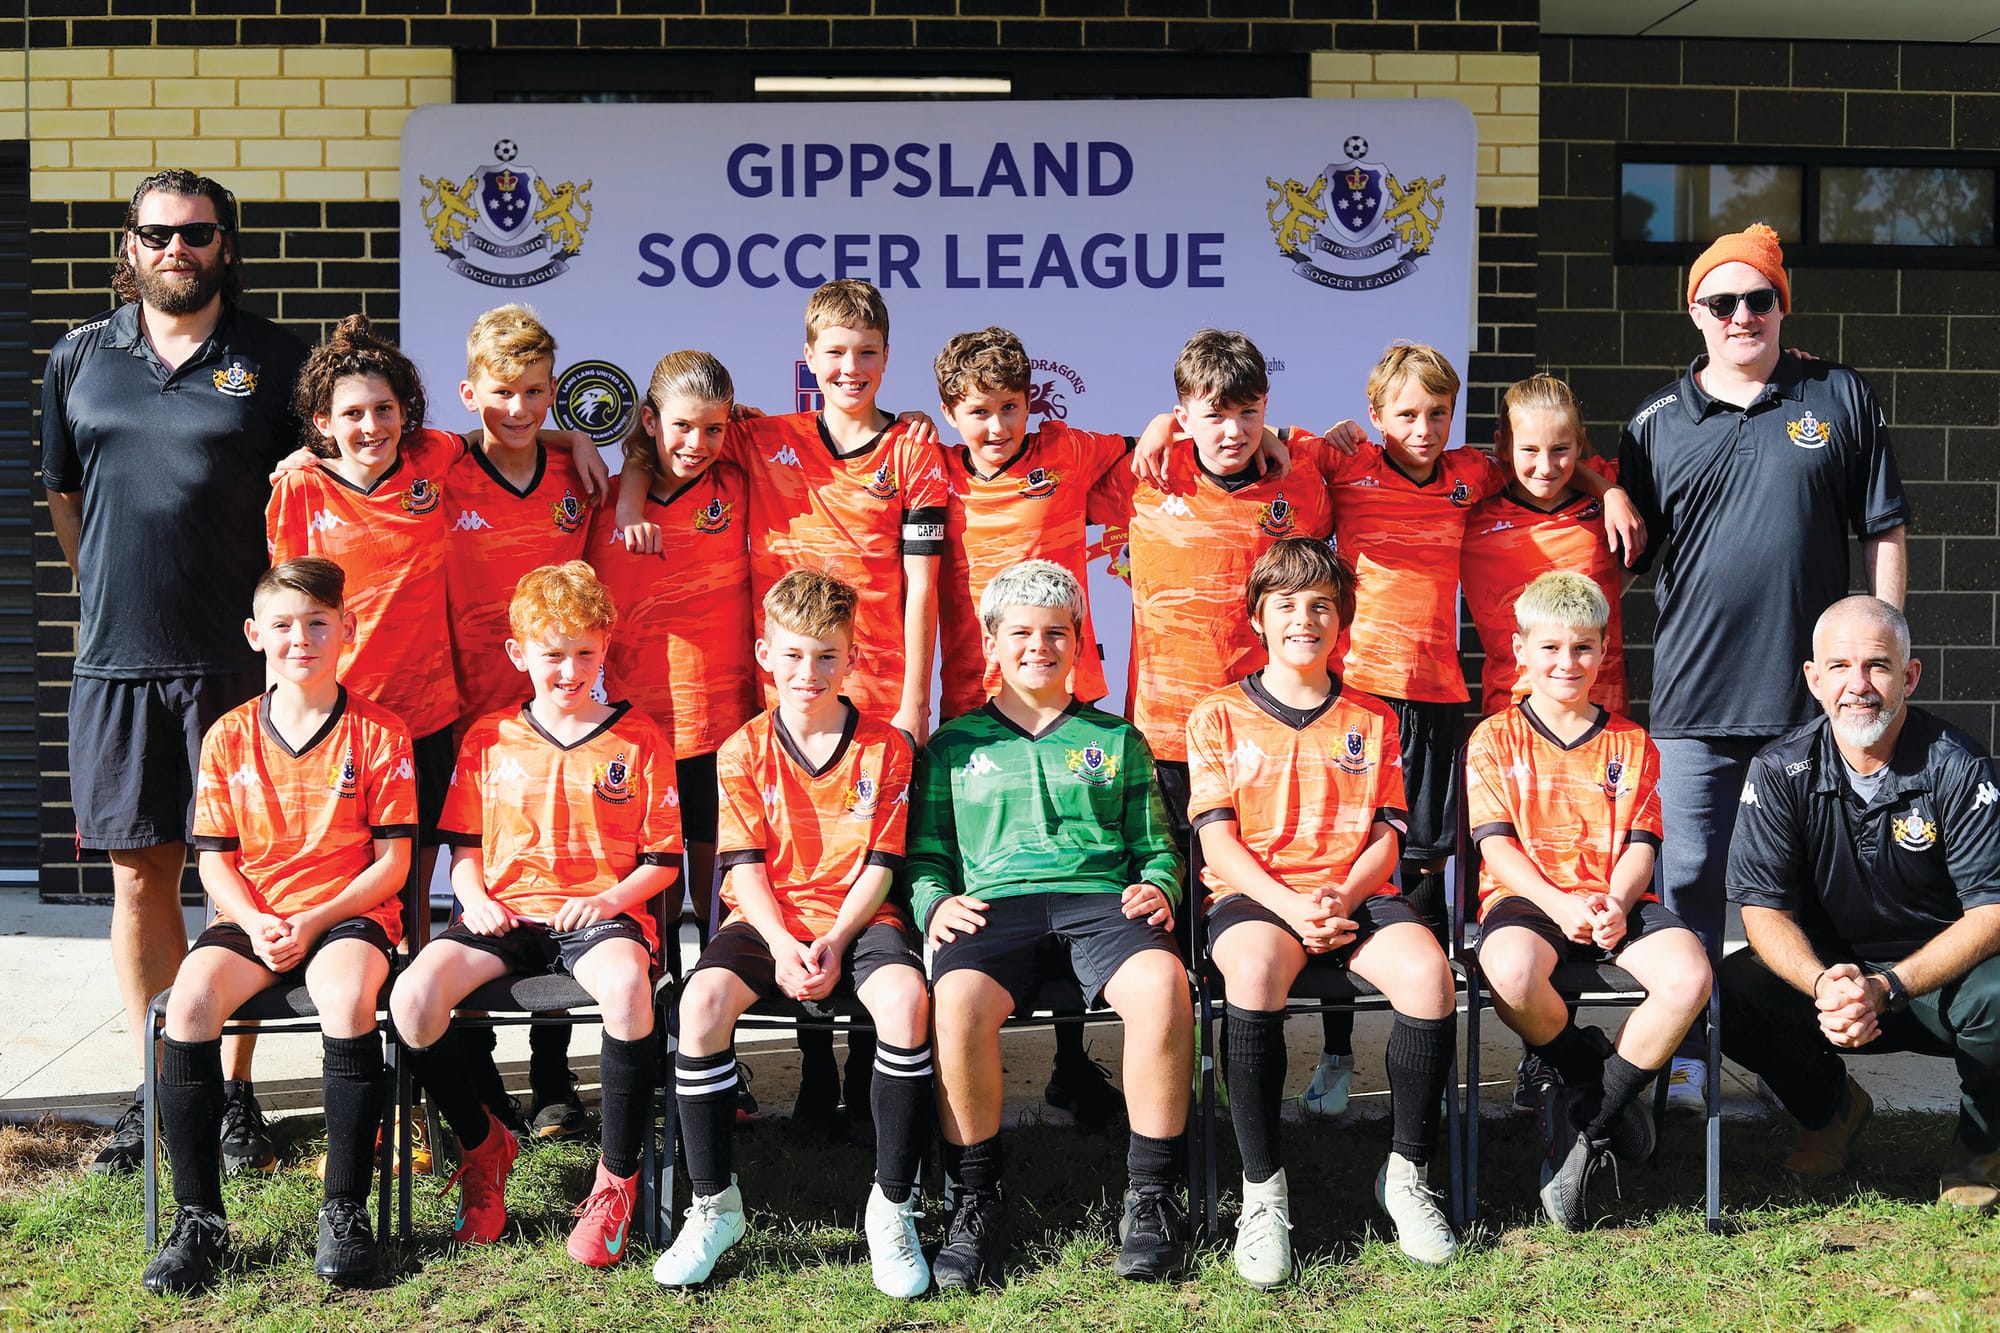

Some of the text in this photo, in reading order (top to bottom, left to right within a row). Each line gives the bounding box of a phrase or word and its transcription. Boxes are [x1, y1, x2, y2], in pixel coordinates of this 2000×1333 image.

[726, 141, 1133, 198] GIPPSLAND
[473, 238, 544, 258] GIPPSLAND
[1321, 239, 1393, 258] GIPPSLAND
[637, 232, 1225, 289] SOCCER LEAGUE
[456, 261, 561, 287] SOCCER LEAGUE
[1302, 265, 1409, 289] SOCCER LEAGUE
[1030, 359, 1086, 394] DRAGONS
[1264, 357, 1286, 375] ights
[562, 376, 577, 393] LANG
[576, 370, 596, 380] LANG
[596, 370, 621, 385] UNITED
[917, 525, 943, 537] CAPTA
[1110, 532, 1129, 541] INVE
